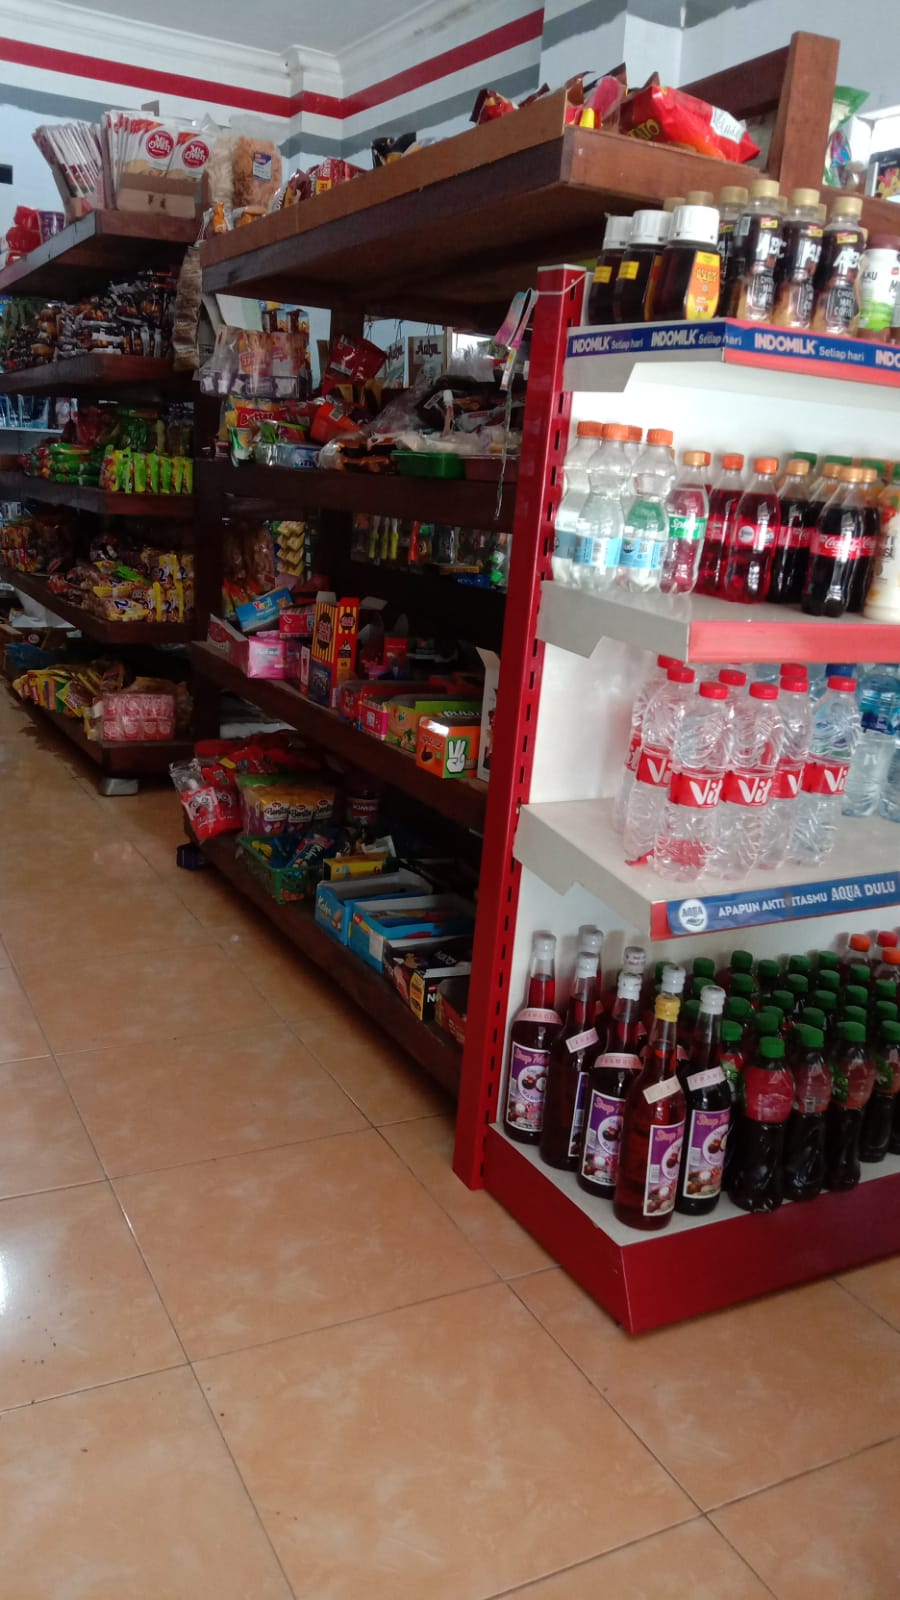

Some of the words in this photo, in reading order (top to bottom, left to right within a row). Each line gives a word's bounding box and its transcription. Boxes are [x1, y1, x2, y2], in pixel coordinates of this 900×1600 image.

[572, 336, 611, 353] INDOMILK
[611, 339, 630, 350] Setiap
[630, 338, 644, 348] hari
[651, 329, 699, 347] INDOMILK
[722, 334, 742, 346] hari
[754, 333, 816, 355] INDOMILK
[819, 346, 846, 361] Setiap
[847, 350, 865, 362] hari
[718, 903, 761, 917] APAPUN
[762, 892, 828, 911] AKTIITASMU
[831, 885, 862, 902] AQUA
[864, 881, 896, 896] DULU
[682, 904, 704, 918] AQUA
